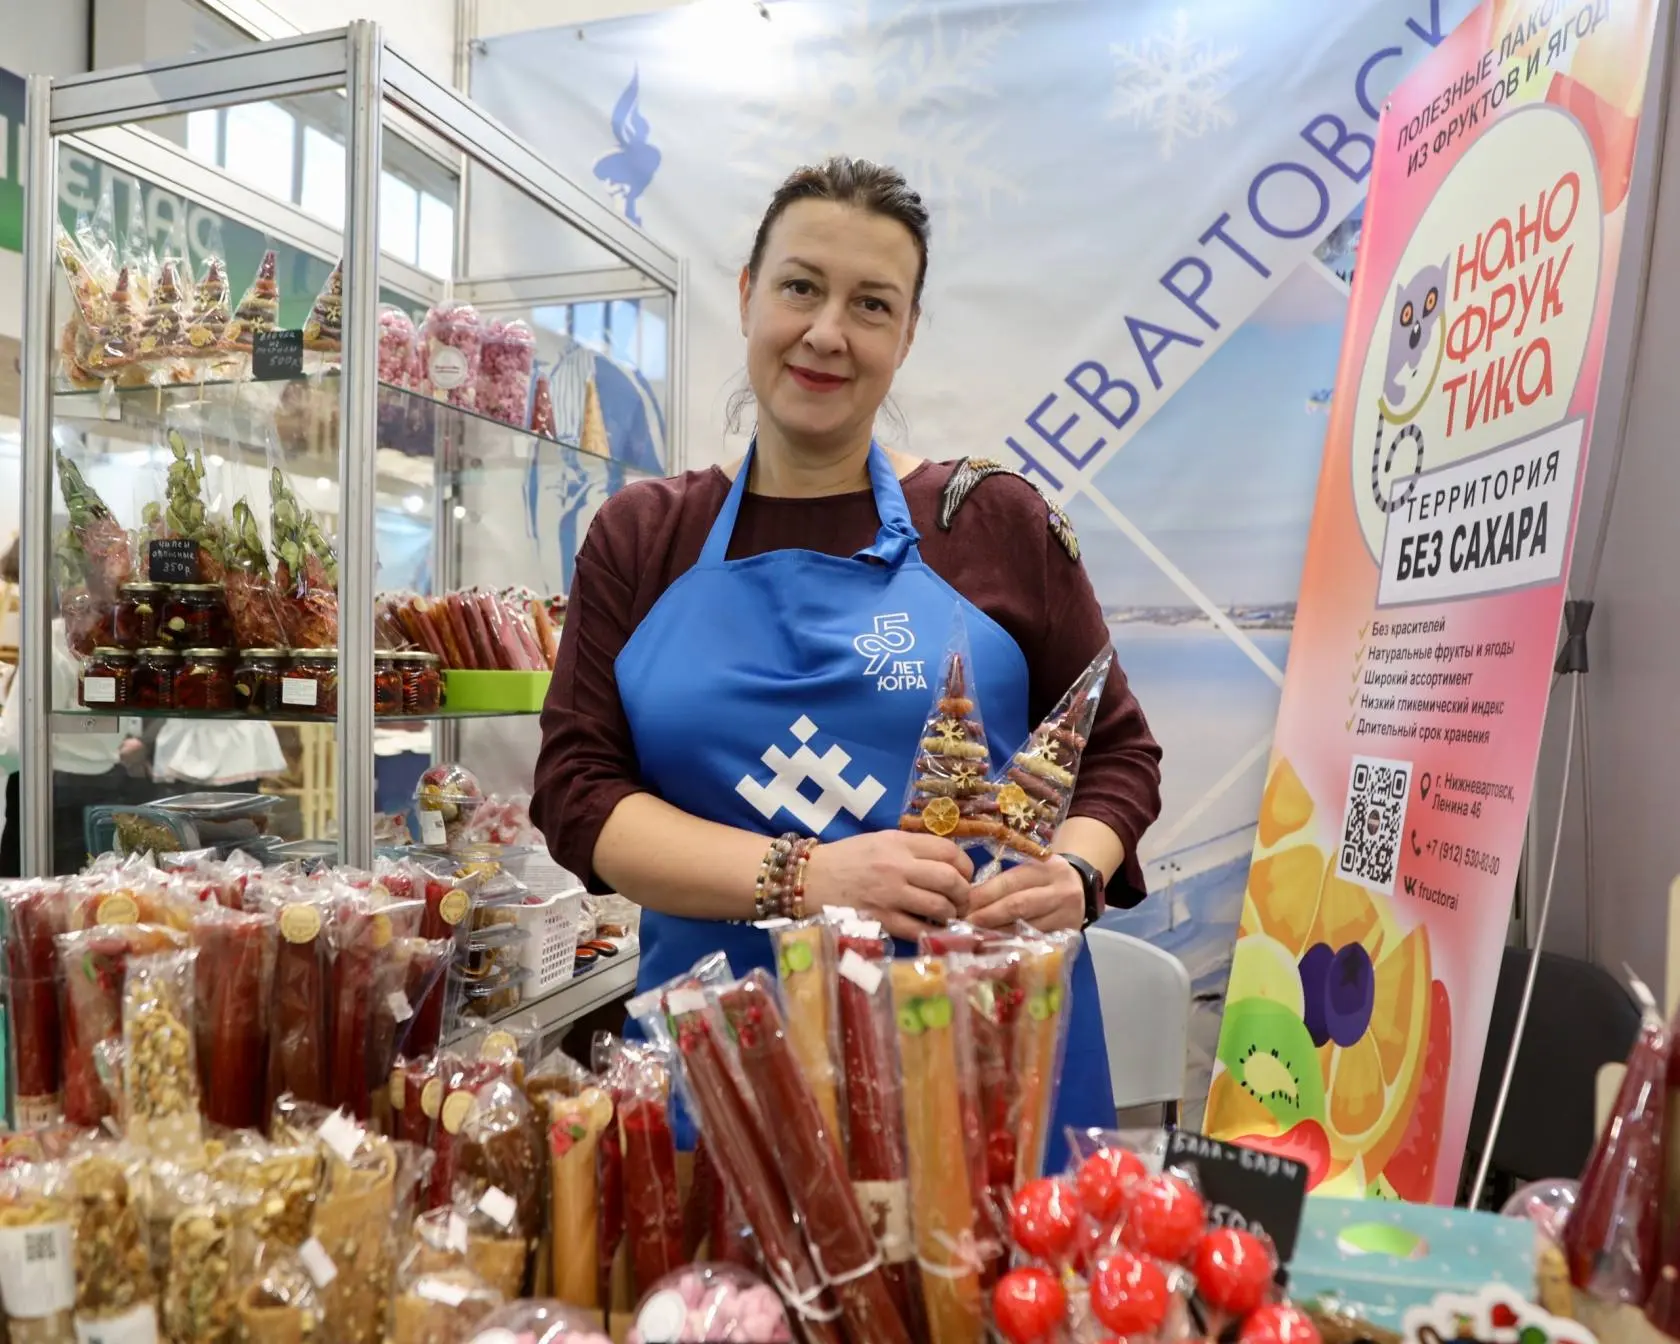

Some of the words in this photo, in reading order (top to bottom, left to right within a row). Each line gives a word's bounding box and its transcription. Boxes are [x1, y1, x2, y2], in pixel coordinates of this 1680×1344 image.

[1397, 48, 1494, 153] ПОЛЕЗНЫЕ
[1497, 0, 1562, 66] ЛАКО
[1407, 142, 1428, 178] ИЗ
[1433, 66, 1520, 153] ФРУКТОВ
[1526, 46, 1541, 83] И
[1446, 242, 1575, 364] ФРУК
[1407, 449, 1560, 524] ТЕРРИТОРИЯ
[1396, 529, 1444, 582] БЕЗ
[1449, 500, 1549, 574] САХАРА
[1372, 620, 1389, 637] Без
[1391, 616, 1446, 639] красителей
[1368, 645, 1433, 664] Натуральные
[1434, 642, 1474, 664] фрукты
[1476, 643, 1483, 657] и
[1484, 640, 1516, 659] ягоды
[891, 660, 925, 675] ЛЕТ
[1364, 669, 1408, 688] Широкий
[1409, 671, 1473, 689] ассортимент
[877, 674, 928, 692] ЮГРА
[1360, 693, 1396, 710] Низкий
[1397, 696, 1470, 714] гликемический
[1471, 700, 1505, 717] индекс
[1356, 718, 1417, 738] Длительный
[1418, 726, 1443, 743] срок
[1443, 727, 1491, 745] хранения
[1431, 793, 1469, 817] Ленина
[1425, 838, 1438, 856] +7
[1440, 842, 1463, 868] (912)
